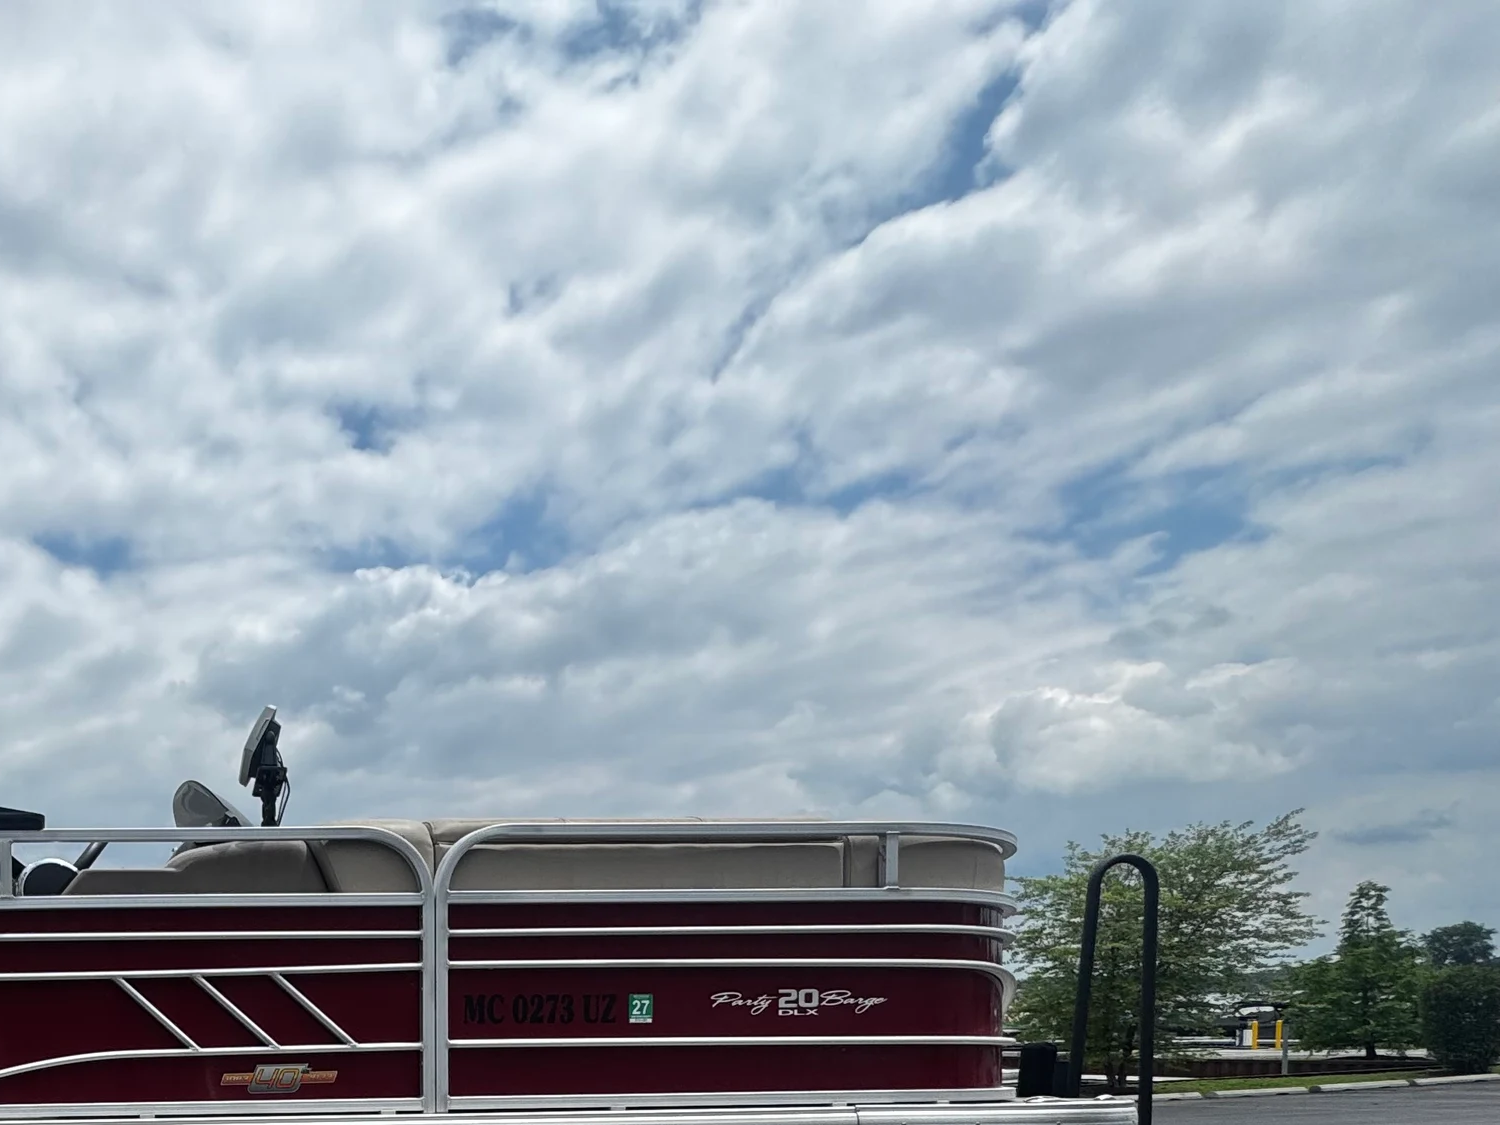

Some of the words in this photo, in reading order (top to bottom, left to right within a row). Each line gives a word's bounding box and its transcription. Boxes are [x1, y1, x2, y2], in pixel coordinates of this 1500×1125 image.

[463, 993, 506, 1025] MC
[512, 993, 576, 1025] 0273
[582, 993, 618, 1025] UZ
[631, 999, 651, 1015] 27
[710, 991, 778, 1016] Party
[778, 988, 820, 1009] 20
[819, 989, 889, 1015] Barge
[778, 1008, 820, 1017] DLX
